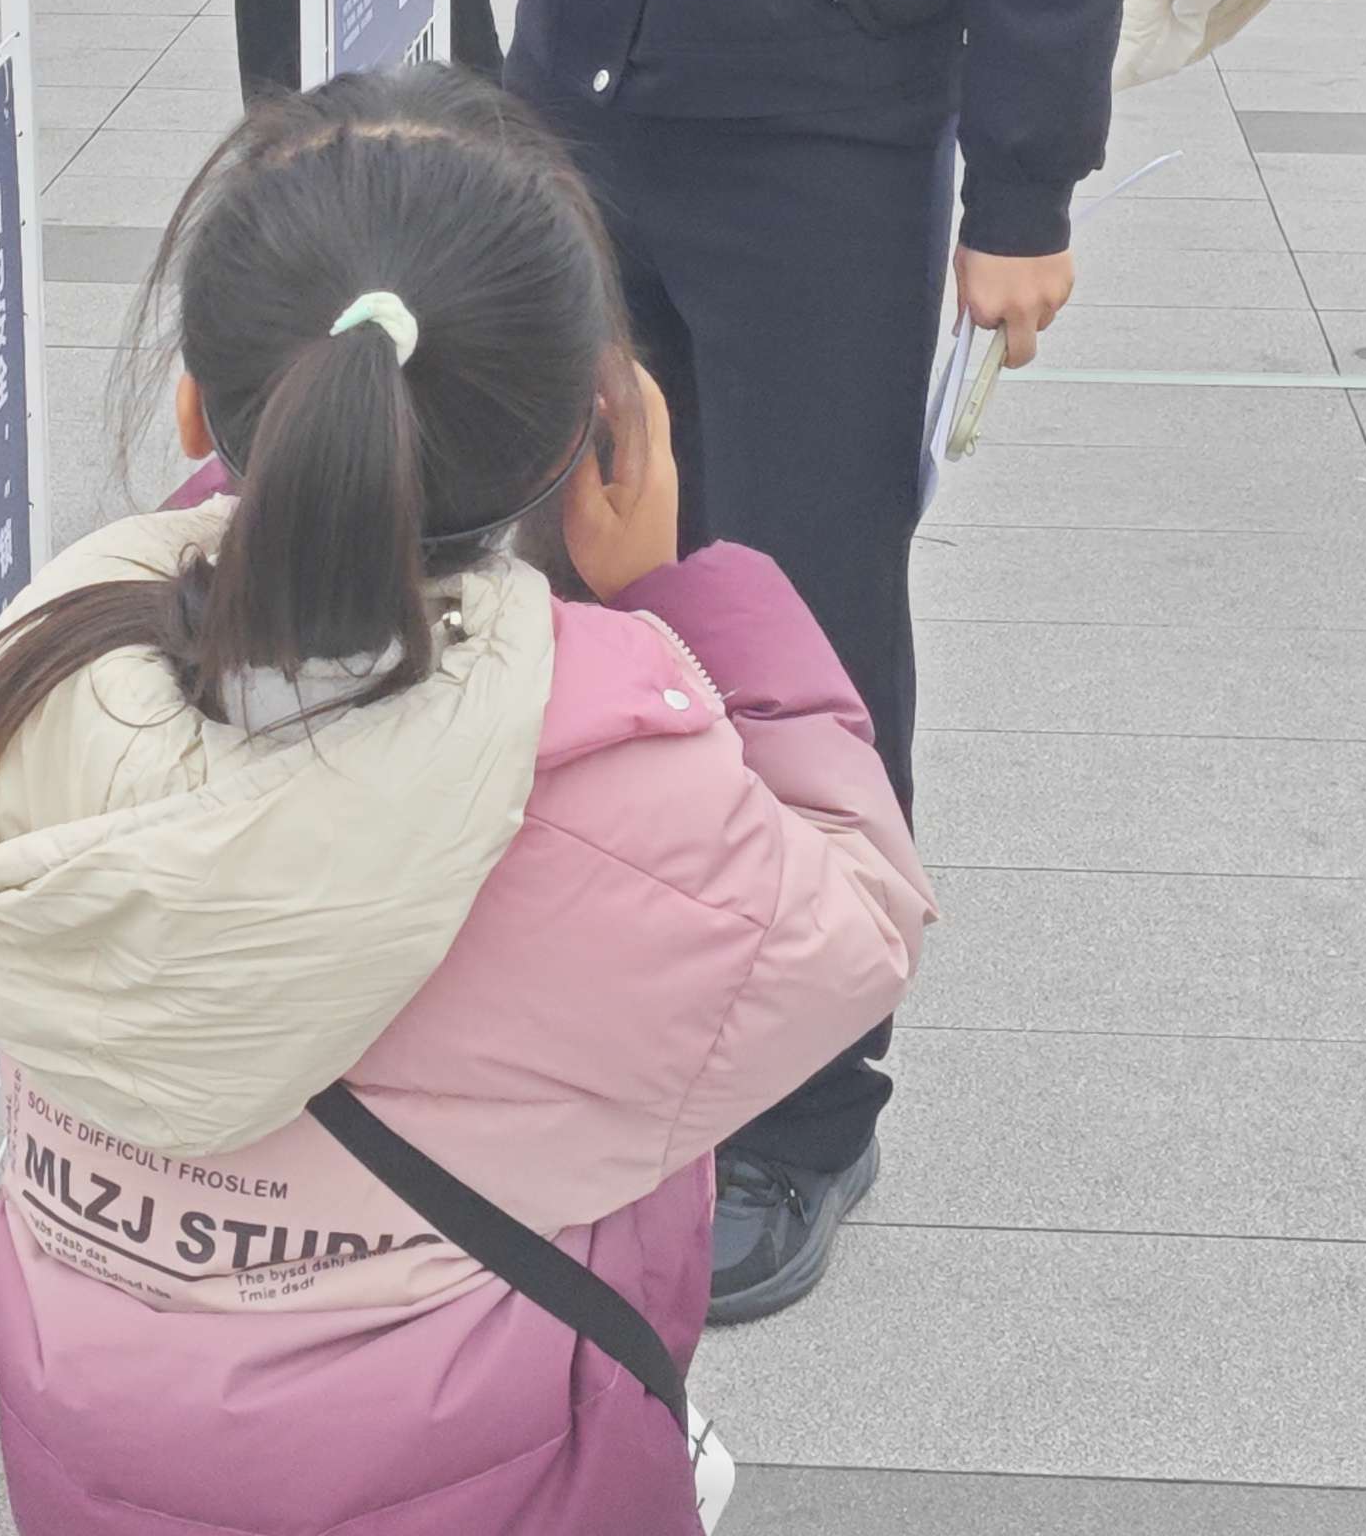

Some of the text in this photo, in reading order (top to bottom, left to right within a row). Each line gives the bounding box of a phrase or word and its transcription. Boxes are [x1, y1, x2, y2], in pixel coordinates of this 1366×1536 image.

[24, 1133, 155, 1244] MLZJ
[27, 1090, 73, 1135] SOLVE
[77, 1122, 172, 1175] DIFFICULT
[178, 1163, 288, 1199] FROSLEM
[236, 1271, 265, 1287] The
[270, 1262, 308, 1282] bysd
